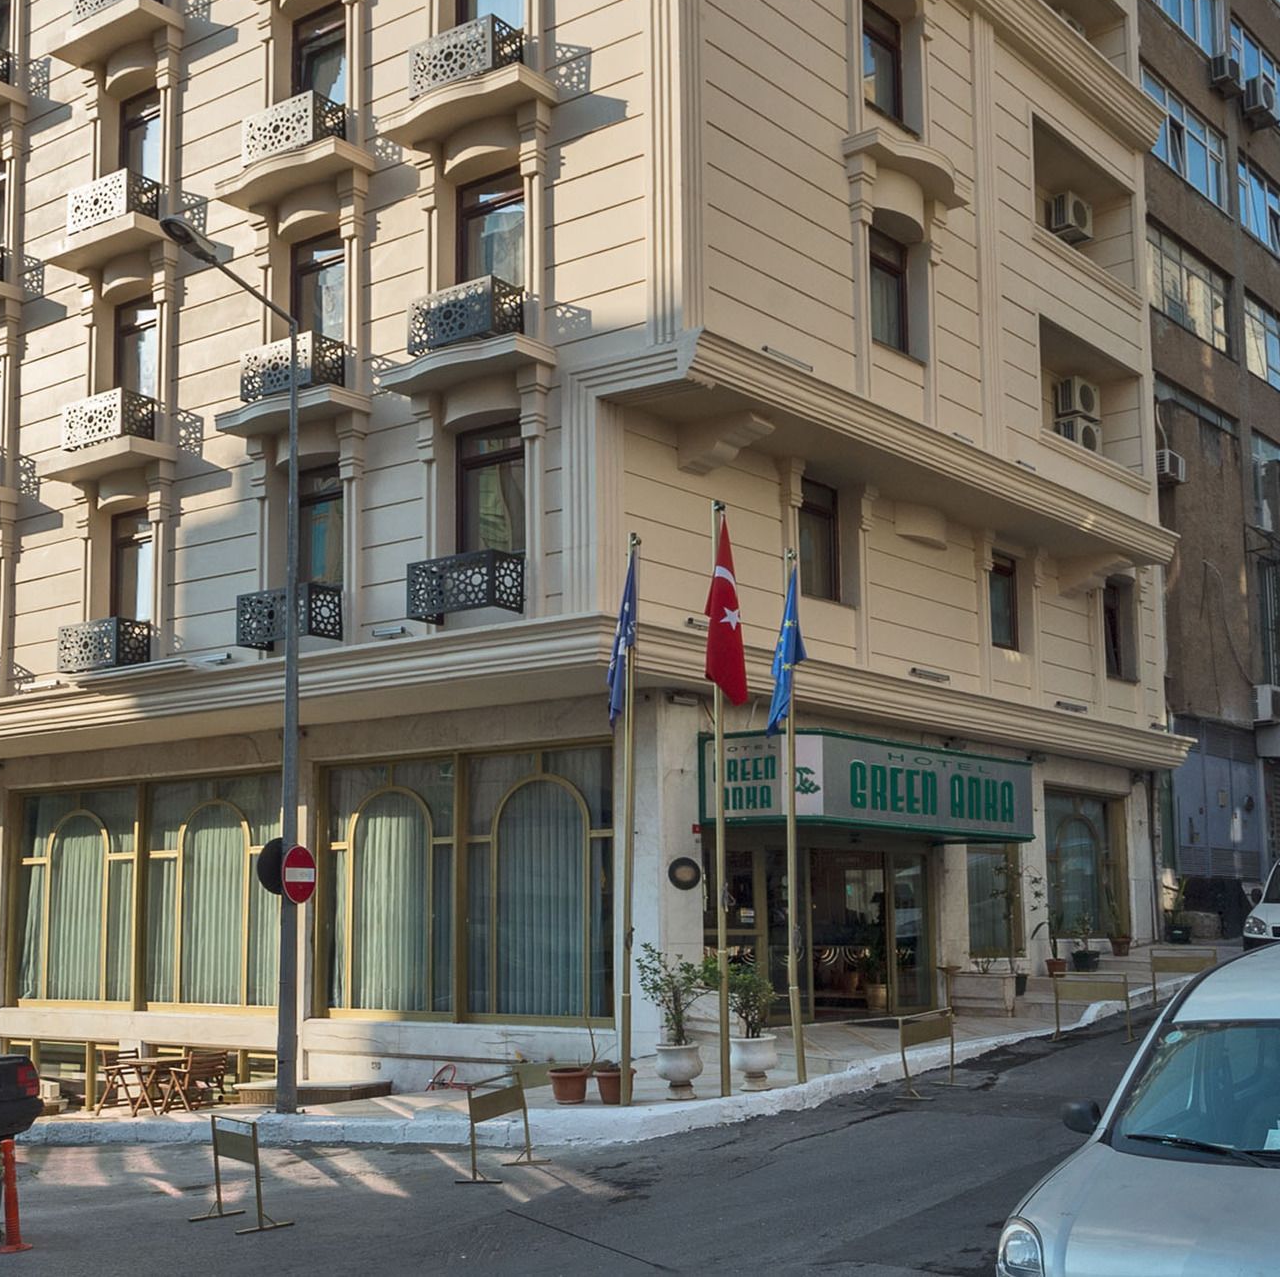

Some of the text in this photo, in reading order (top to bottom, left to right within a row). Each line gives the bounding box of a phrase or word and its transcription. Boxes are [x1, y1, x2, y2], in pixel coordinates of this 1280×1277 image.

[714, 744, 776, 753] OTEL
[713, 754, 776, 782] REEN
[887, 752, 991, 775] HOTEL
[850, 759, 1014, 823] GREEN ANKA
